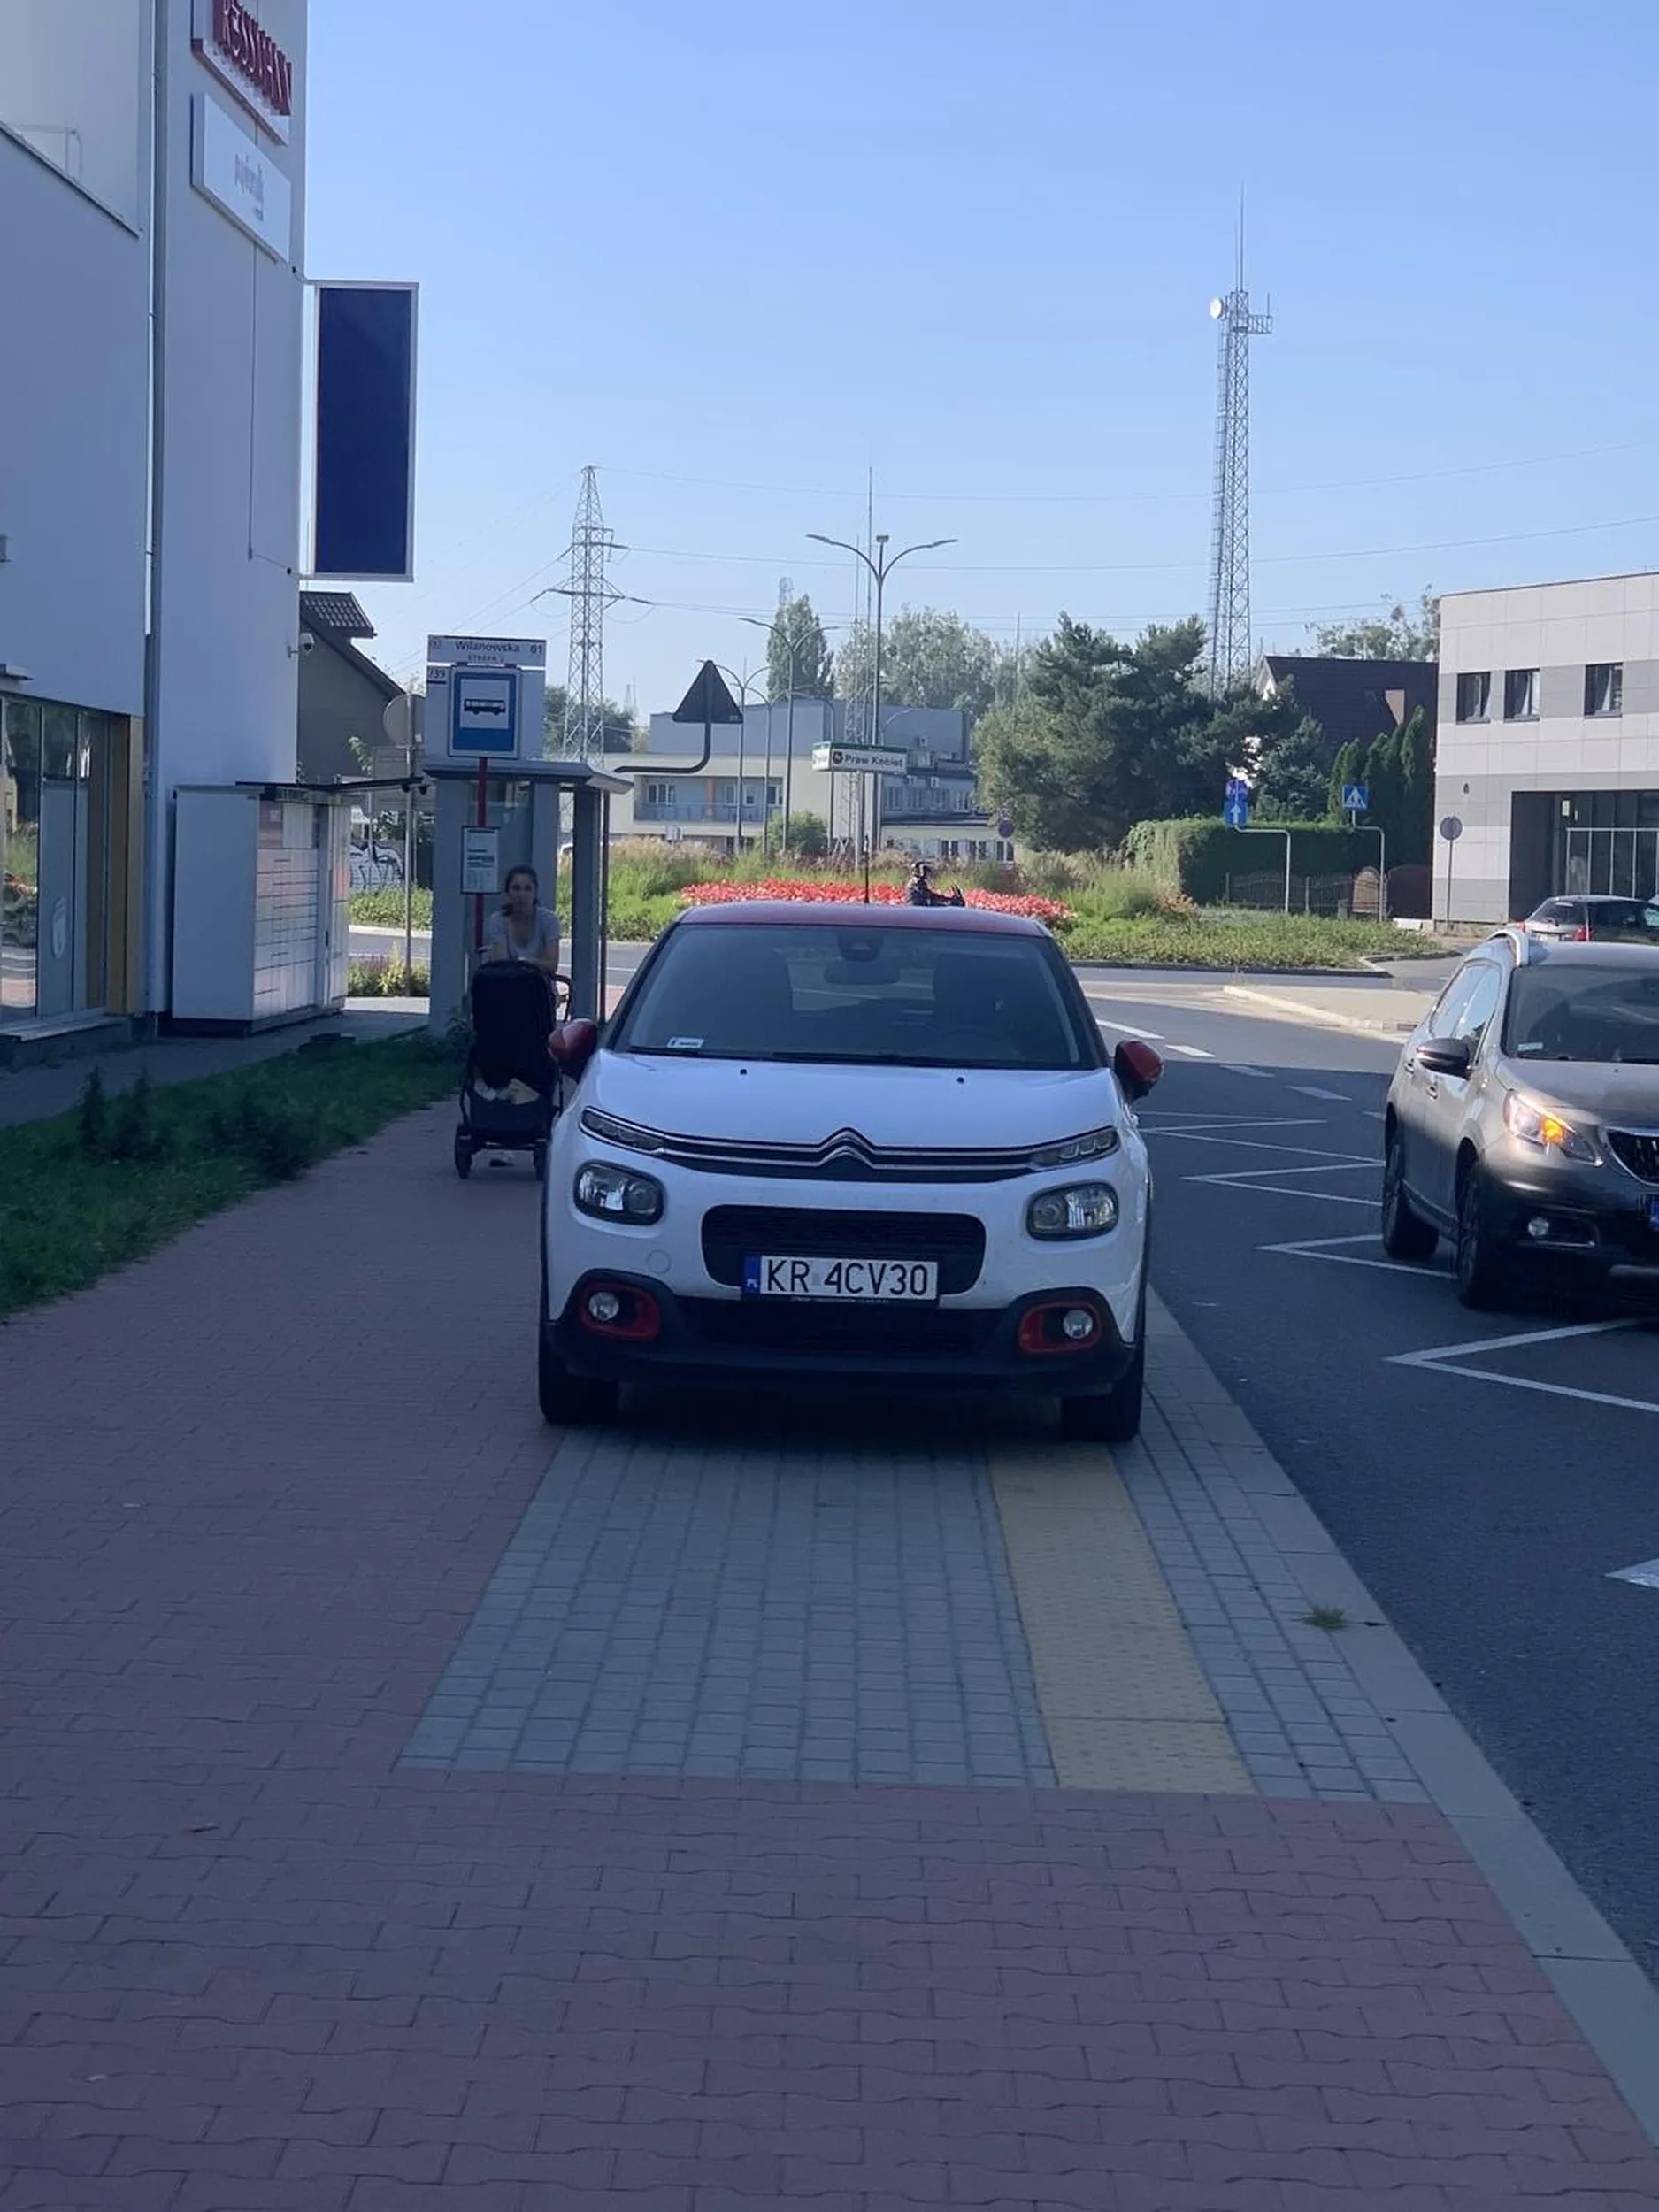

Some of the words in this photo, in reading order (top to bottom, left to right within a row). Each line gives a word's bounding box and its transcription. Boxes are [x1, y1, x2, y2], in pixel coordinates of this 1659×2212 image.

[455, 641, 520, 653] Wilanowska
[530, 645, 542, 654] 01
[844, 754, 869, 764] Praw
[872, 757, 903, 767] Kobiet
[767, 1259, 810, 1292] KR
[824, 1262, 928, 1295] 4CV30
